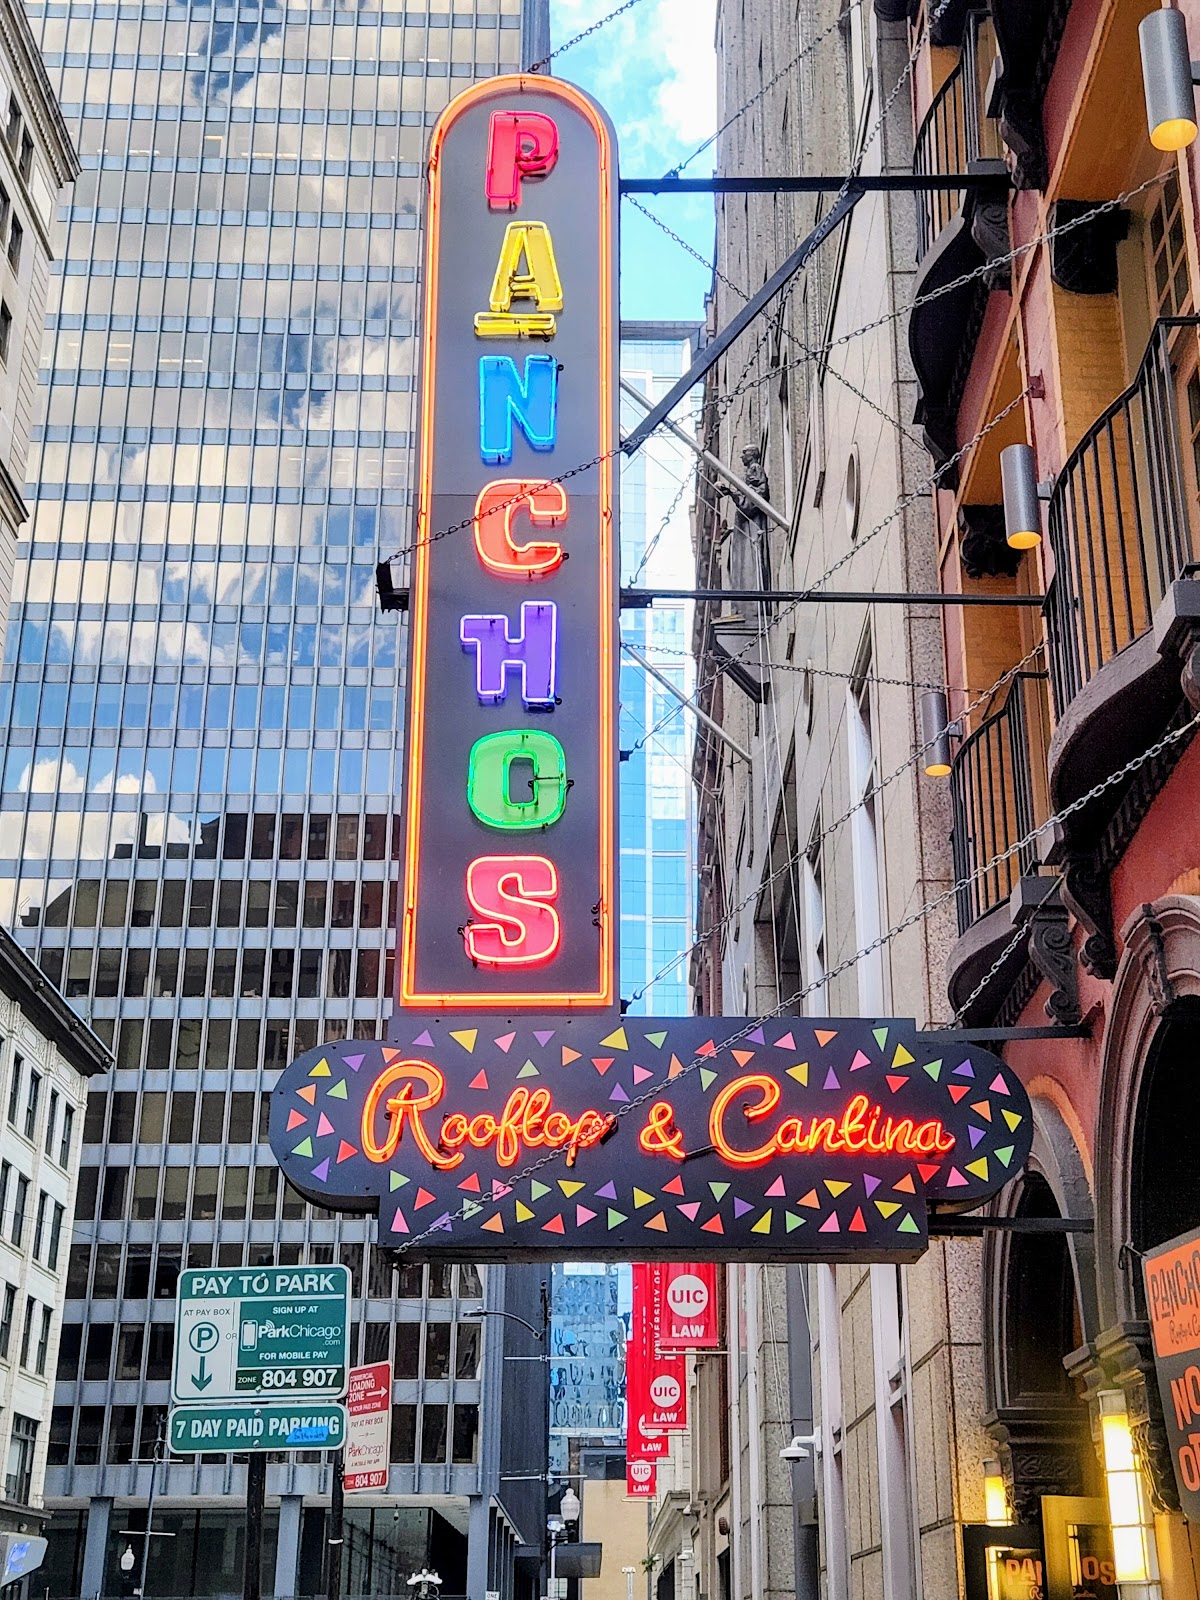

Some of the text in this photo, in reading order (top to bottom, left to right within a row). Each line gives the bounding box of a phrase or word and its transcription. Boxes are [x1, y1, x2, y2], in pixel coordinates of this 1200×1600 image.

[458, 109, 568, 967] PANCHOS
[361, 1059, 956, 1168] Rooftop & Cantina
[654, 1269, 661, 1284] OF
[191, 1273, 336, 1295] PAY TO PARK
[672, 1289, 704, 1304] UIC
[183, 1307, 231, 1317] AT PAY BOX
[272, 1305, 319, 1315] SIGN UP AT
[258, 1323, 341, 1341] ParkChicago
[671, 1324, 705, 1338] LAW
[259, 1350, 329, 1360] FOR MOBILE PAY
[237, 1368, 338, 1388] ZONE 804 907
[350, 1378, 375, 1392] LOADING
[348, 1391, 365, 1403] ZONE
[653, 1386, 678, 1397] UIC
[653, 1412, 678, 1423] LAW
[176, 1420, 186, 1439] 7
[191, 1419, 222, 1438] DAY
[226, 1418, 264, 1438] PAID
[641, 1443, 662, 1452] LAW
[633, 1467, 650, 1475] UIC
[355, 1473, 368, 1488] 804
[369, 1471, 383, 1486] 907
[633, 1484, 650, 1492] LAW
